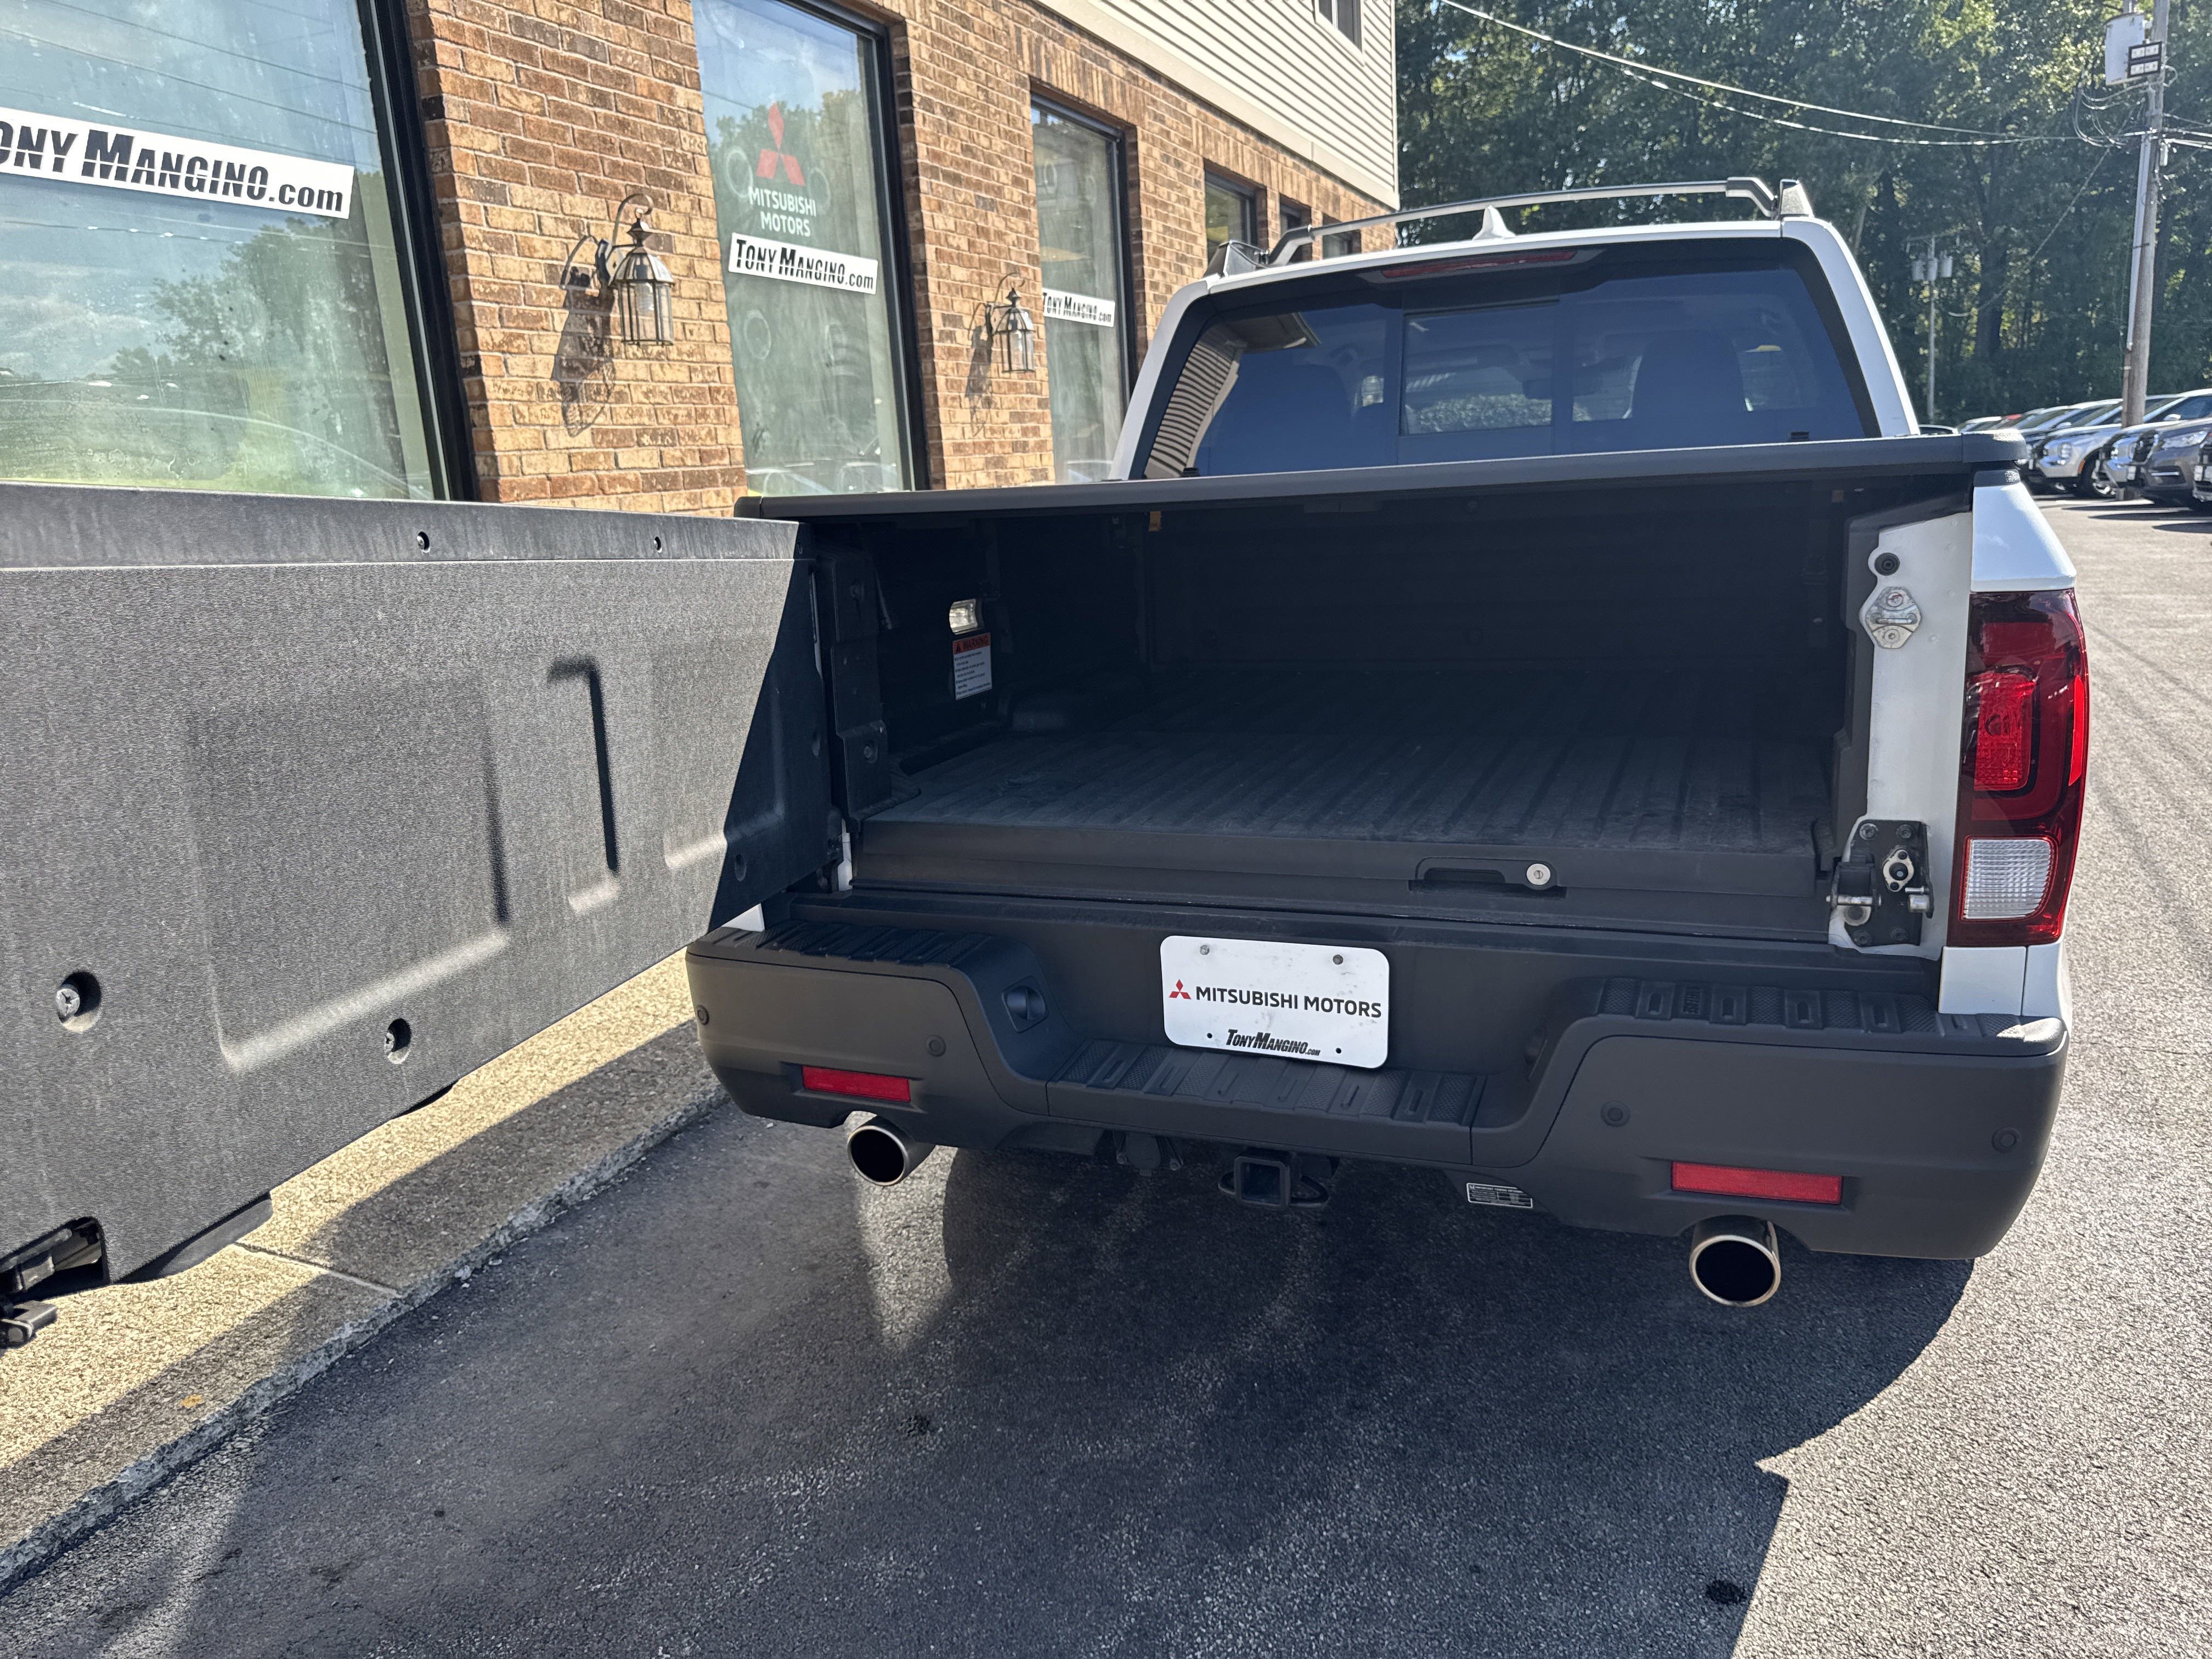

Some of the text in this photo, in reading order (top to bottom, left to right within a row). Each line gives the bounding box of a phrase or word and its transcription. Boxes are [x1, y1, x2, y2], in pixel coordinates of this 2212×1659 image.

[748, 187, 816, 217] MITSUBISHI
[760, 212, 811, 236] MOTORS
[964, 636, 988, 649] WARNING
[1196, 986, 1381, 1018] MITSUBISHI MOTORS
